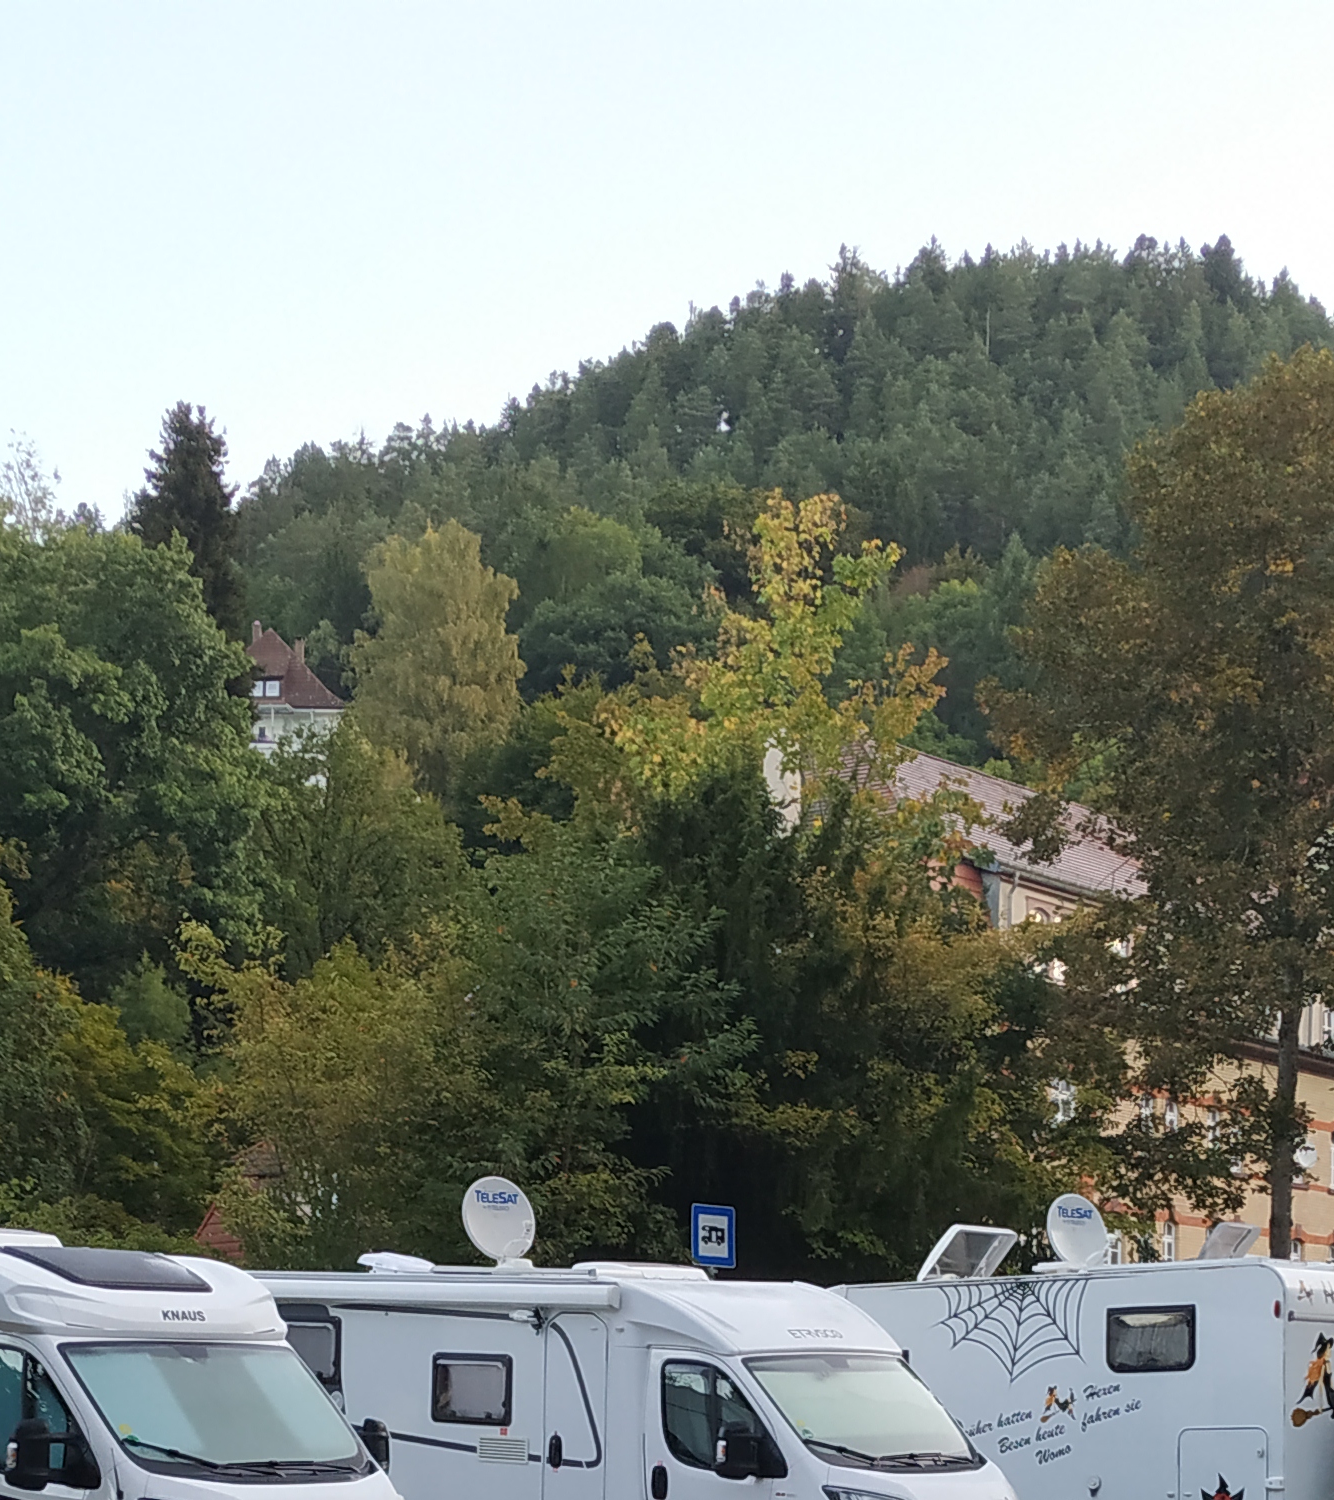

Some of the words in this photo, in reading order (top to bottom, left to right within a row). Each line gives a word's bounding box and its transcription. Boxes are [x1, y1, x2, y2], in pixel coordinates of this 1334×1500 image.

[161, 1309, 206, 1322] KNAUS
[956, 1418, 993, 1438] üher
[997, 1411, 1033, 1429] hatten
[1083, 1383, 1121, 1402] Hexen
[998, 1436, 1031, 1454] Besen
[1035, 1424, 1066, 1442] heute
[1081, 1406, 1121, 1433] fahren
[1124, 1399, 1142, 1414] sie
[1035, 1444, 1072, 1466] Womo
